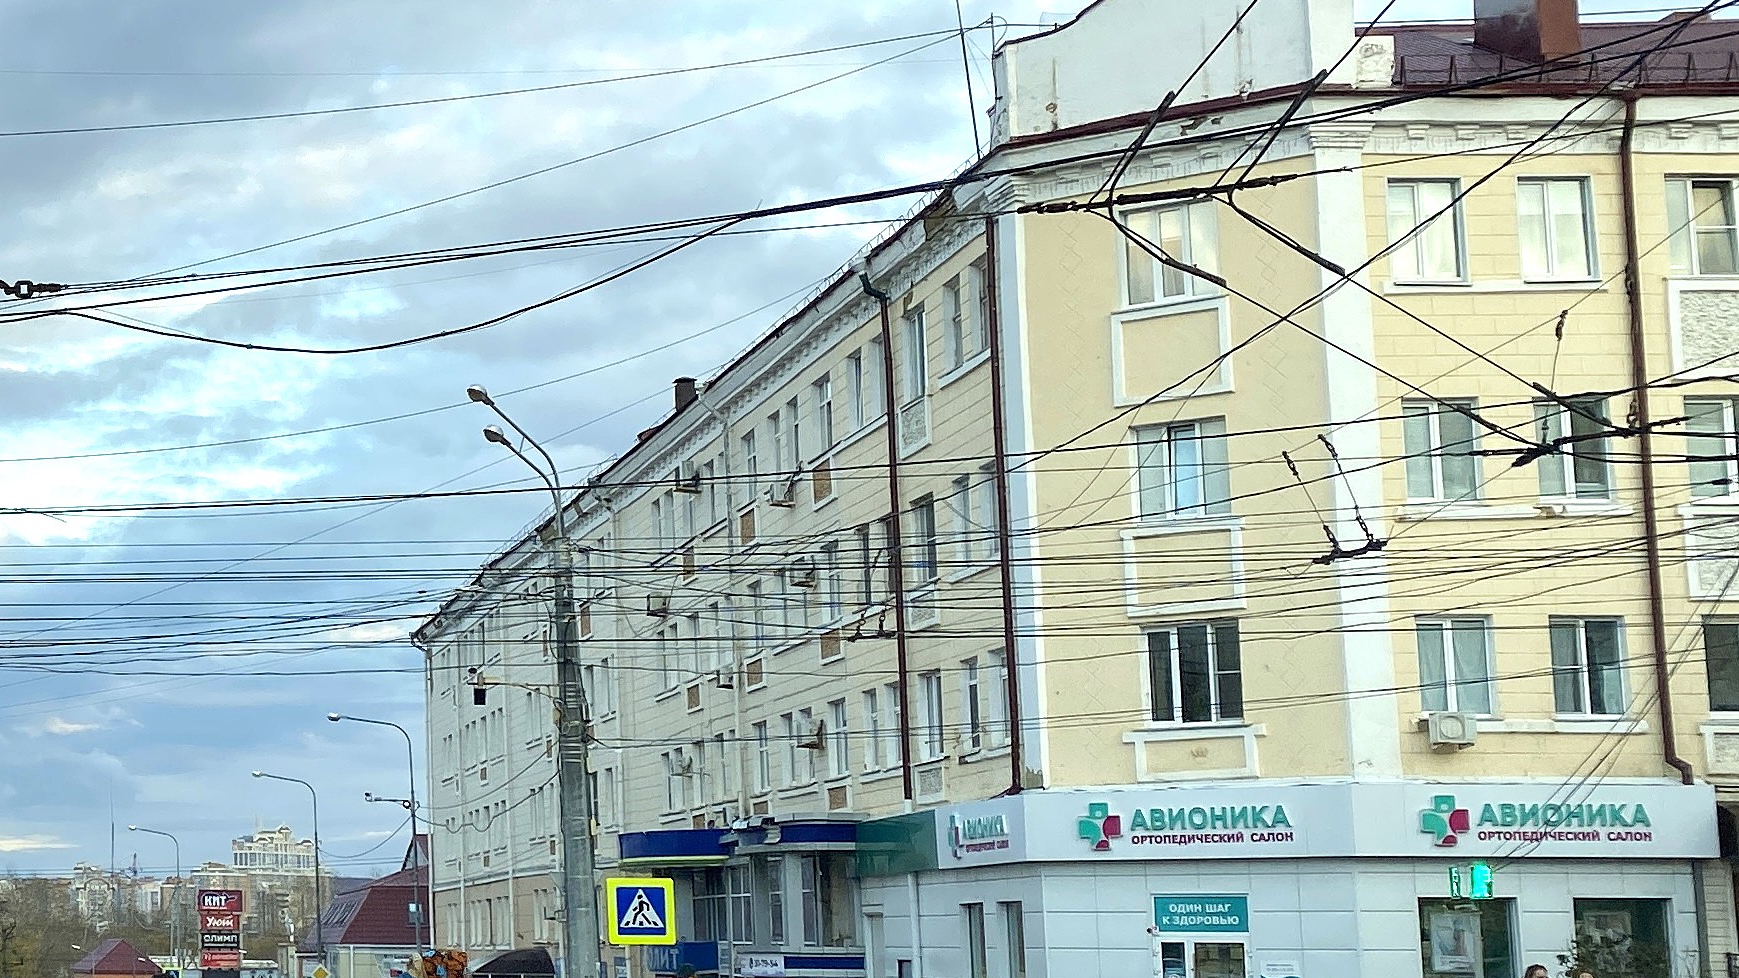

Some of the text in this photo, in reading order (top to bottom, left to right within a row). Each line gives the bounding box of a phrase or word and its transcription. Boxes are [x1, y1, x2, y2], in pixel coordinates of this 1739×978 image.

[1130, 804, 1292, 831] АВИОНИКА
[1477, 803, 1652, 828] АВИОНИКА
[1131, 831, 1294, 846] ОРТОПЕДИЧЕСКИЙ САЛОН
[1477, 829, 1653, 844] ОРТОПЕДИЧЕСКИЙ САЛОН
[1169, 903, 1232, 914] ОДИН ШАГ
[1162, 915, 1240, 926] К ЗДОРОВЬЮ
